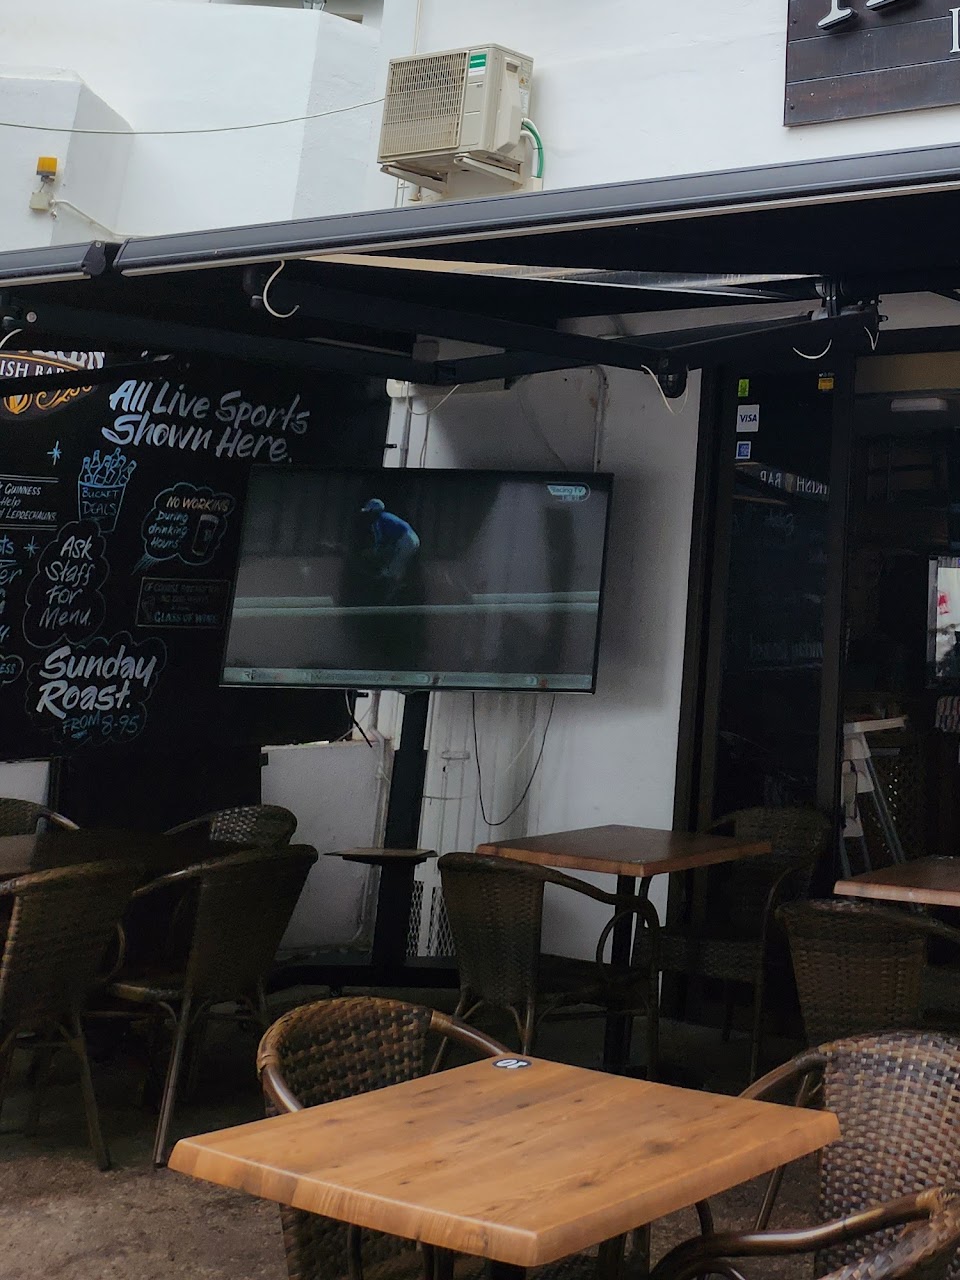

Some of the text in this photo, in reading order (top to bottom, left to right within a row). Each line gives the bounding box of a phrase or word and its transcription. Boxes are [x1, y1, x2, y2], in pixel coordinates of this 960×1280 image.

[109, 380, 310, 434] All Live Sports
[740, 414, 757, 423] VISA
[101, 410, 292, 463] Shown Here.
[166, 496, 180, 508] NO
[45, 560, 96, 588] Staff
[38, 645, 157, 687] Sunday
[35, 679, 131, 719] Roast.
